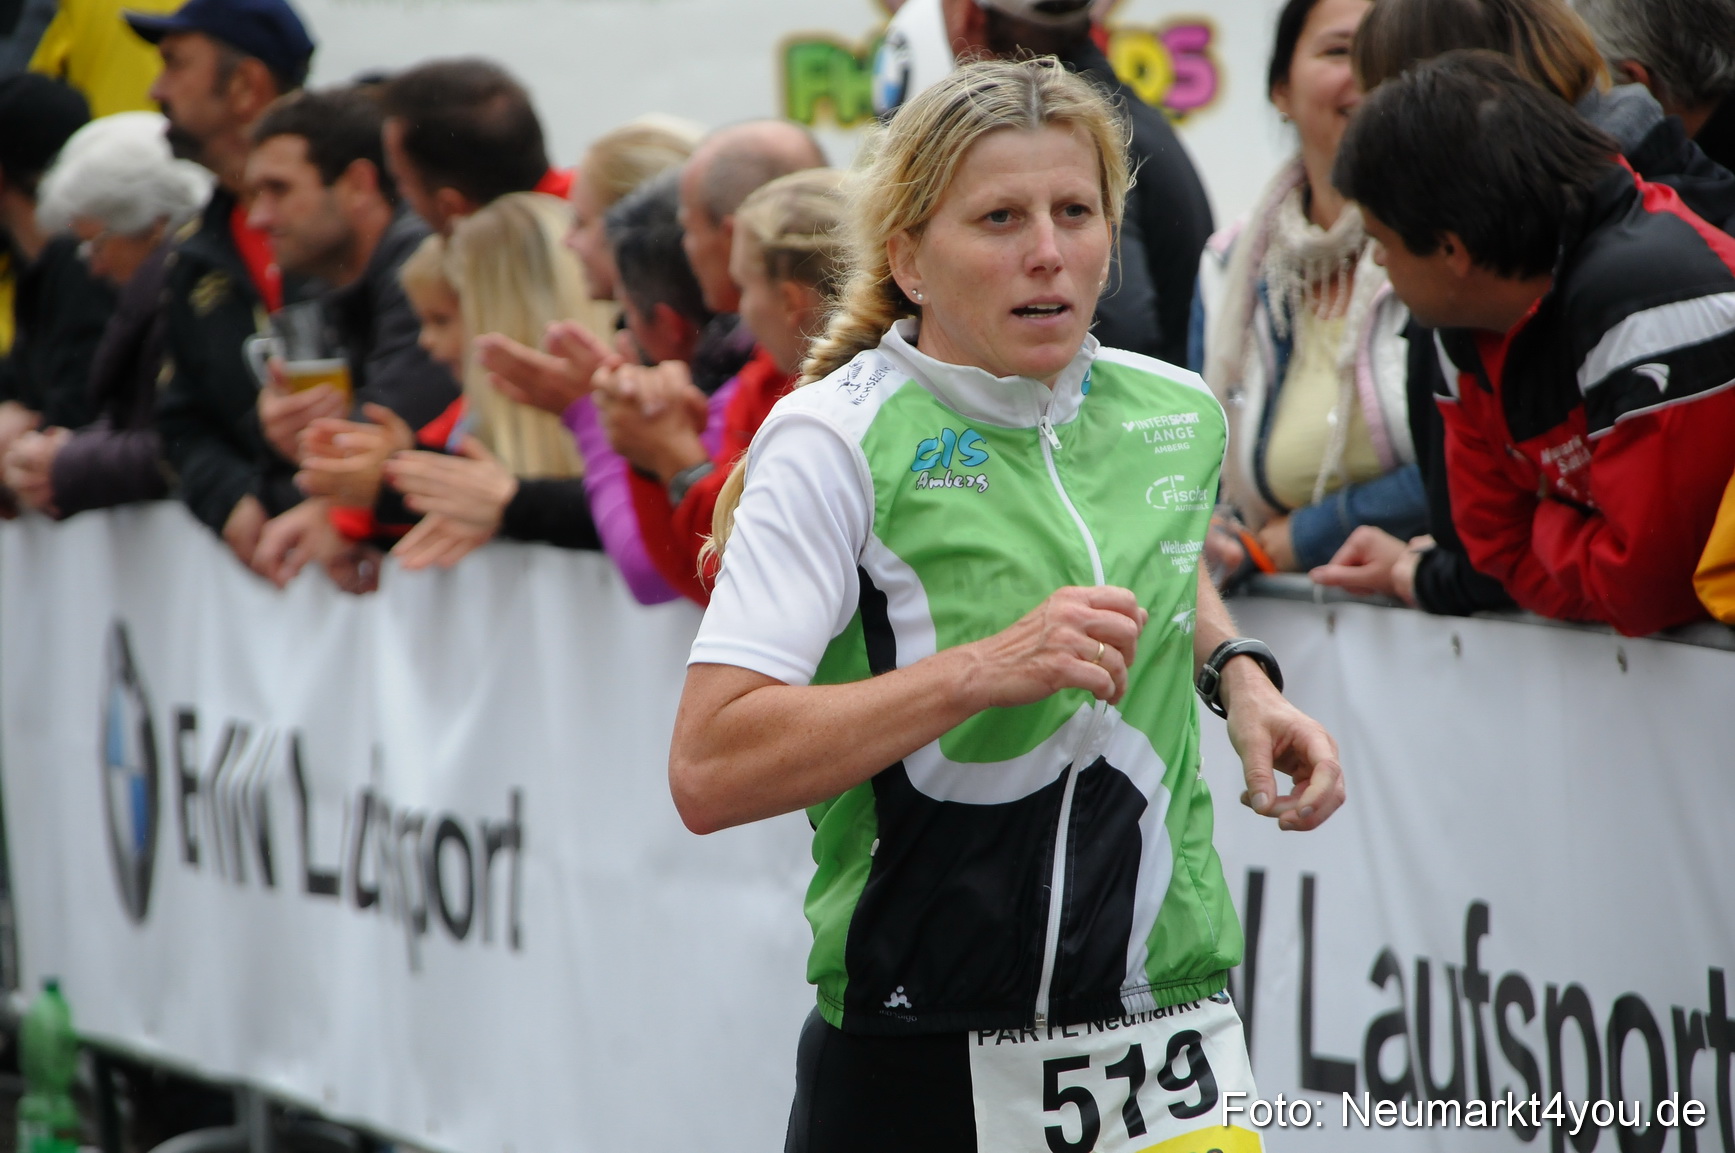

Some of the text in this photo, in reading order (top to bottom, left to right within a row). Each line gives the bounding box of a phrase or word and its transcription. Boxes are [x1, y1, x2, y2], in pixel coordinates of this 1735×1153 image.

[1143, 426, 1196, 444] LANGE
[1154, 441, 1191, 454] AMBERG
[915, 469, 990, 493] Amberg
[1043, 1029, 1219, 1153] 519
